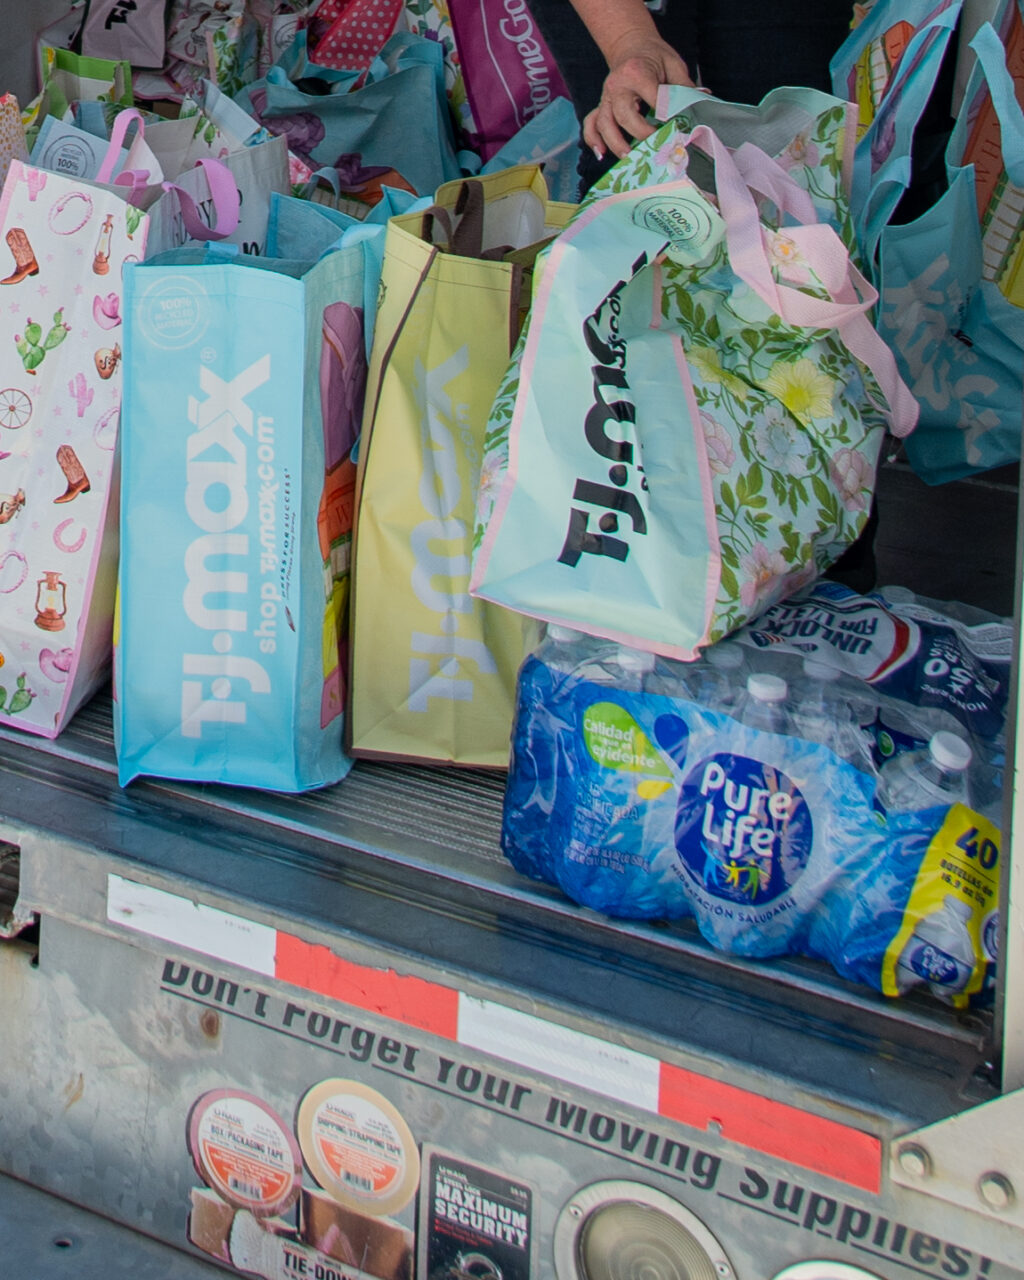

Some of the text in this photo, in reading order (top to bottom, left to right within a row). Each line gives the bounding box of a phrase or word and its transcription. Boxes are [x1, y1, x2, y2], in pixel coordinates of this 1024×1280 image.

[58, 158, 79, 169] 100%
[656, 209, 684, 236] RECYCLED
[668, 208, 693, 232] 100%
[160, 297, 192, 310] 100%
[254, 582, 282, 654] shop
[765, 620, 873, 655] UNLOCK
[584, 719, 634, 742] Calidad
[592, 745, 655, 768] evidente
[700, 761, 792, 820] Pure
[702, 802, 776, 858] Life
[955, 826, 999, 870] 40
[940, 859, 981, 889] BOTELLAS
[941, 872, 961, 890] 16.9
[670, 863, 797, 923] HIDRATACIÓN SALUDABLE
[437, 1056, 532, 1110] Your
[546, 1097, 721, 1190] Moving
[267, 1147, 283, 1161] TAPE
[386, 1142, 401, 1155] TAPE
[436, 1180, 527, 1231] MAXIMUM
[435, 1198, 527, 1248] SECURITY
